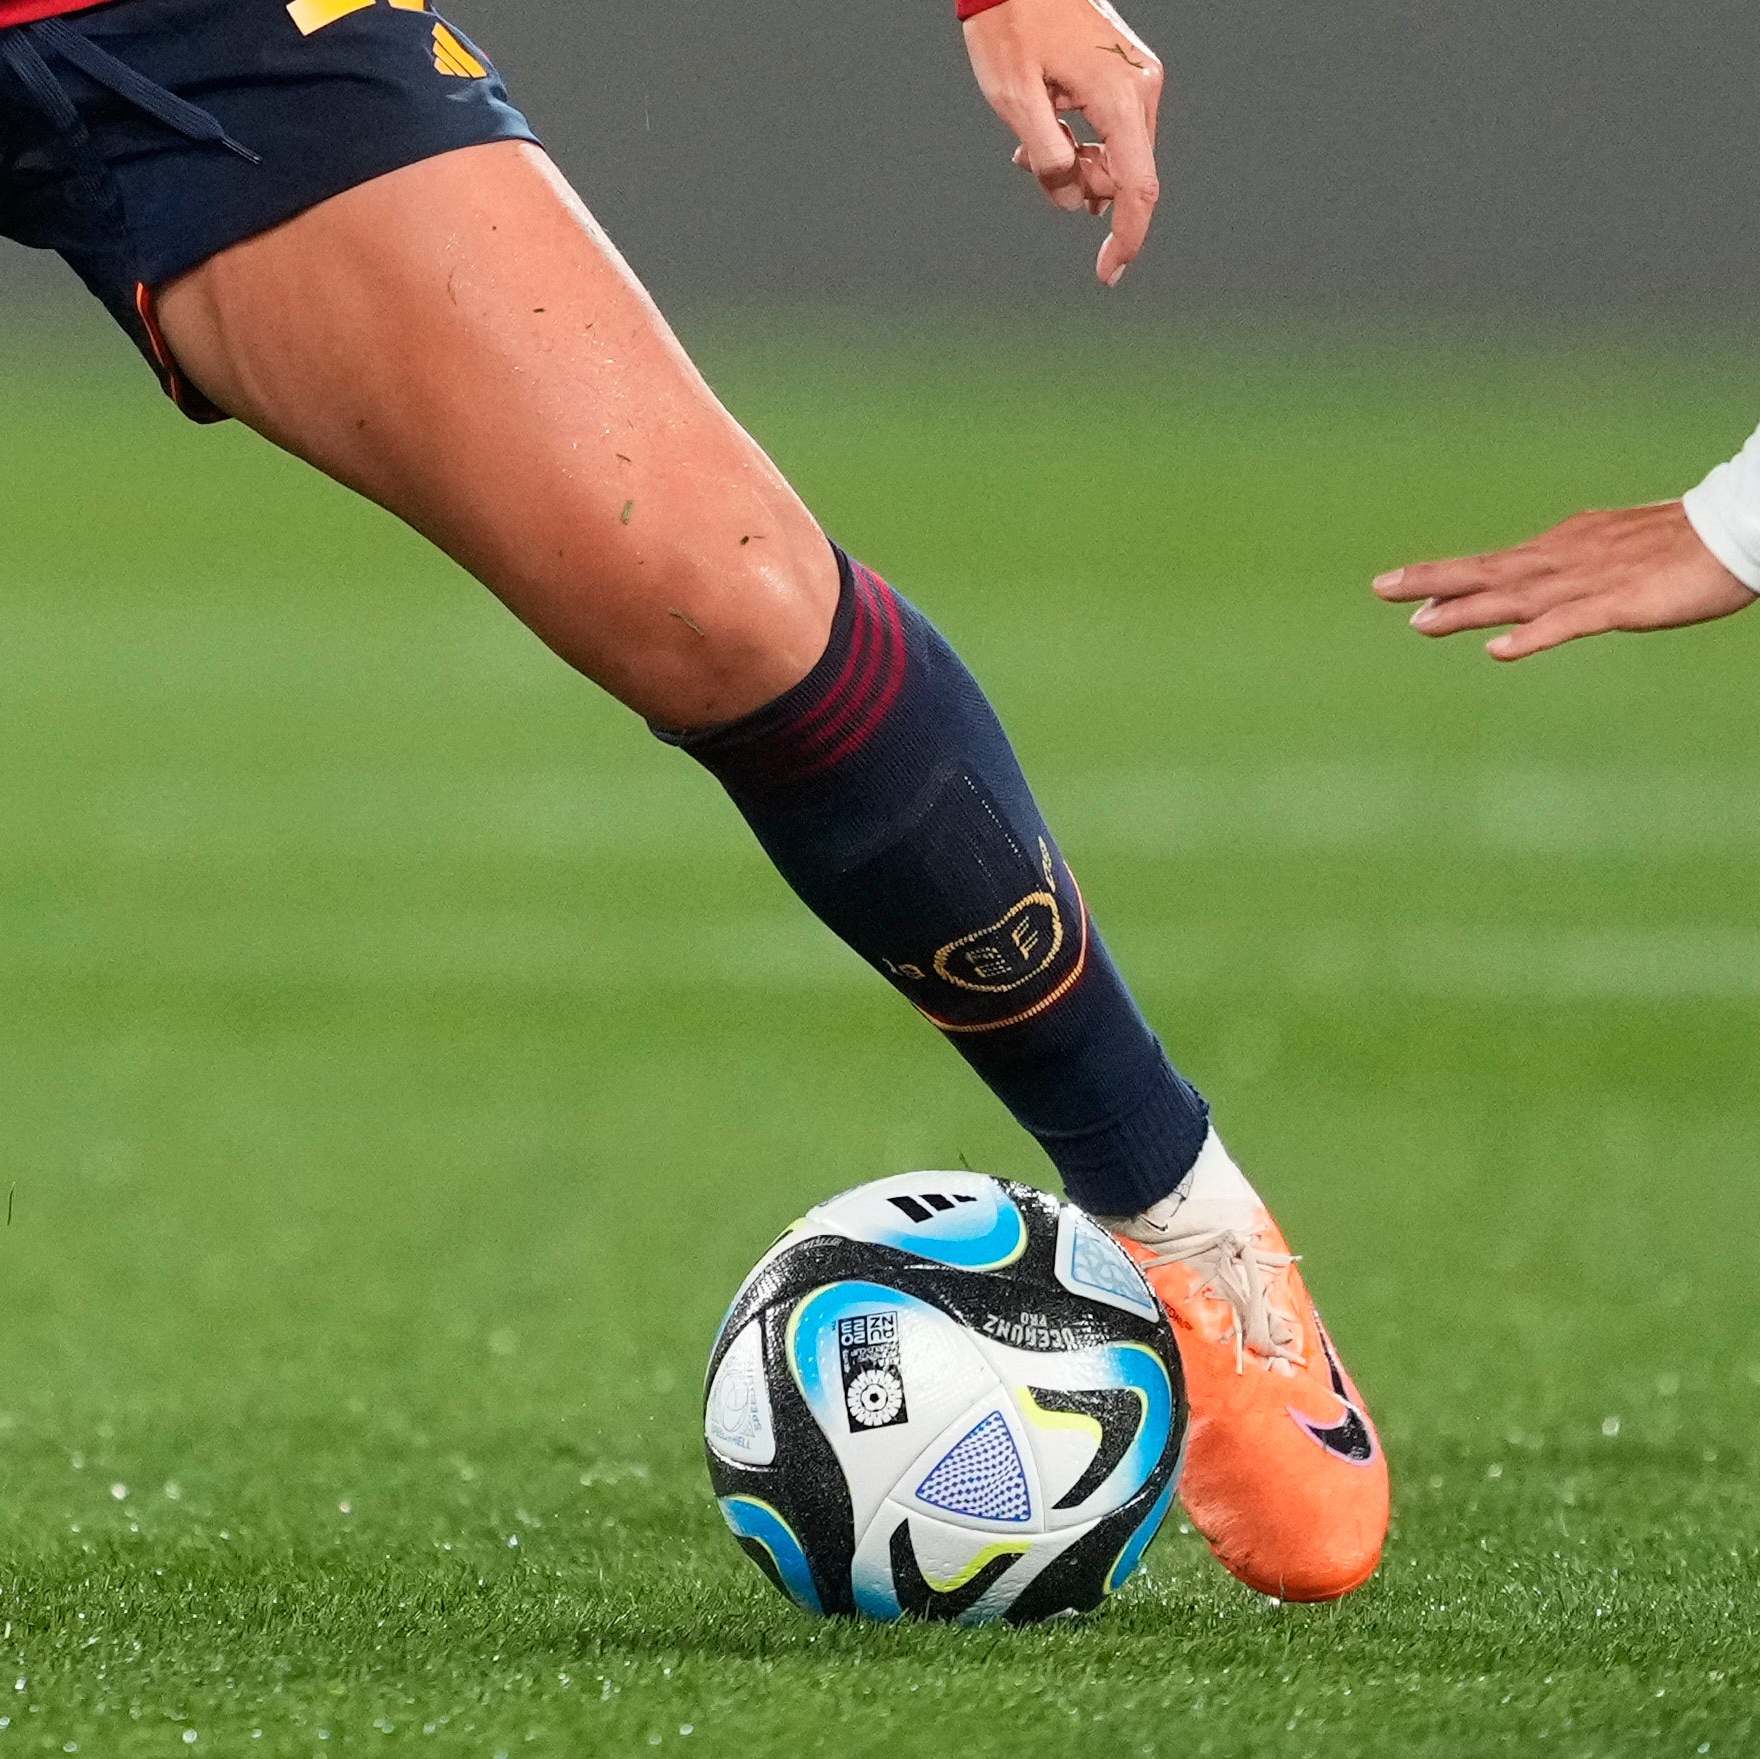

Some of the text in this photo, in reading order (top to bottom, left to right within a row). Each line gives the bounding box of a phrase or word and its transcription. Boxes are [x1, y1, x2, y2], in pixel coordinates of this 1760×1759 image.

[839, 1315, 895, 1334] NZ 23
[1020, 1311, 1047, 1327] PRO
[841, 1327, 896, 1346] AU 20
